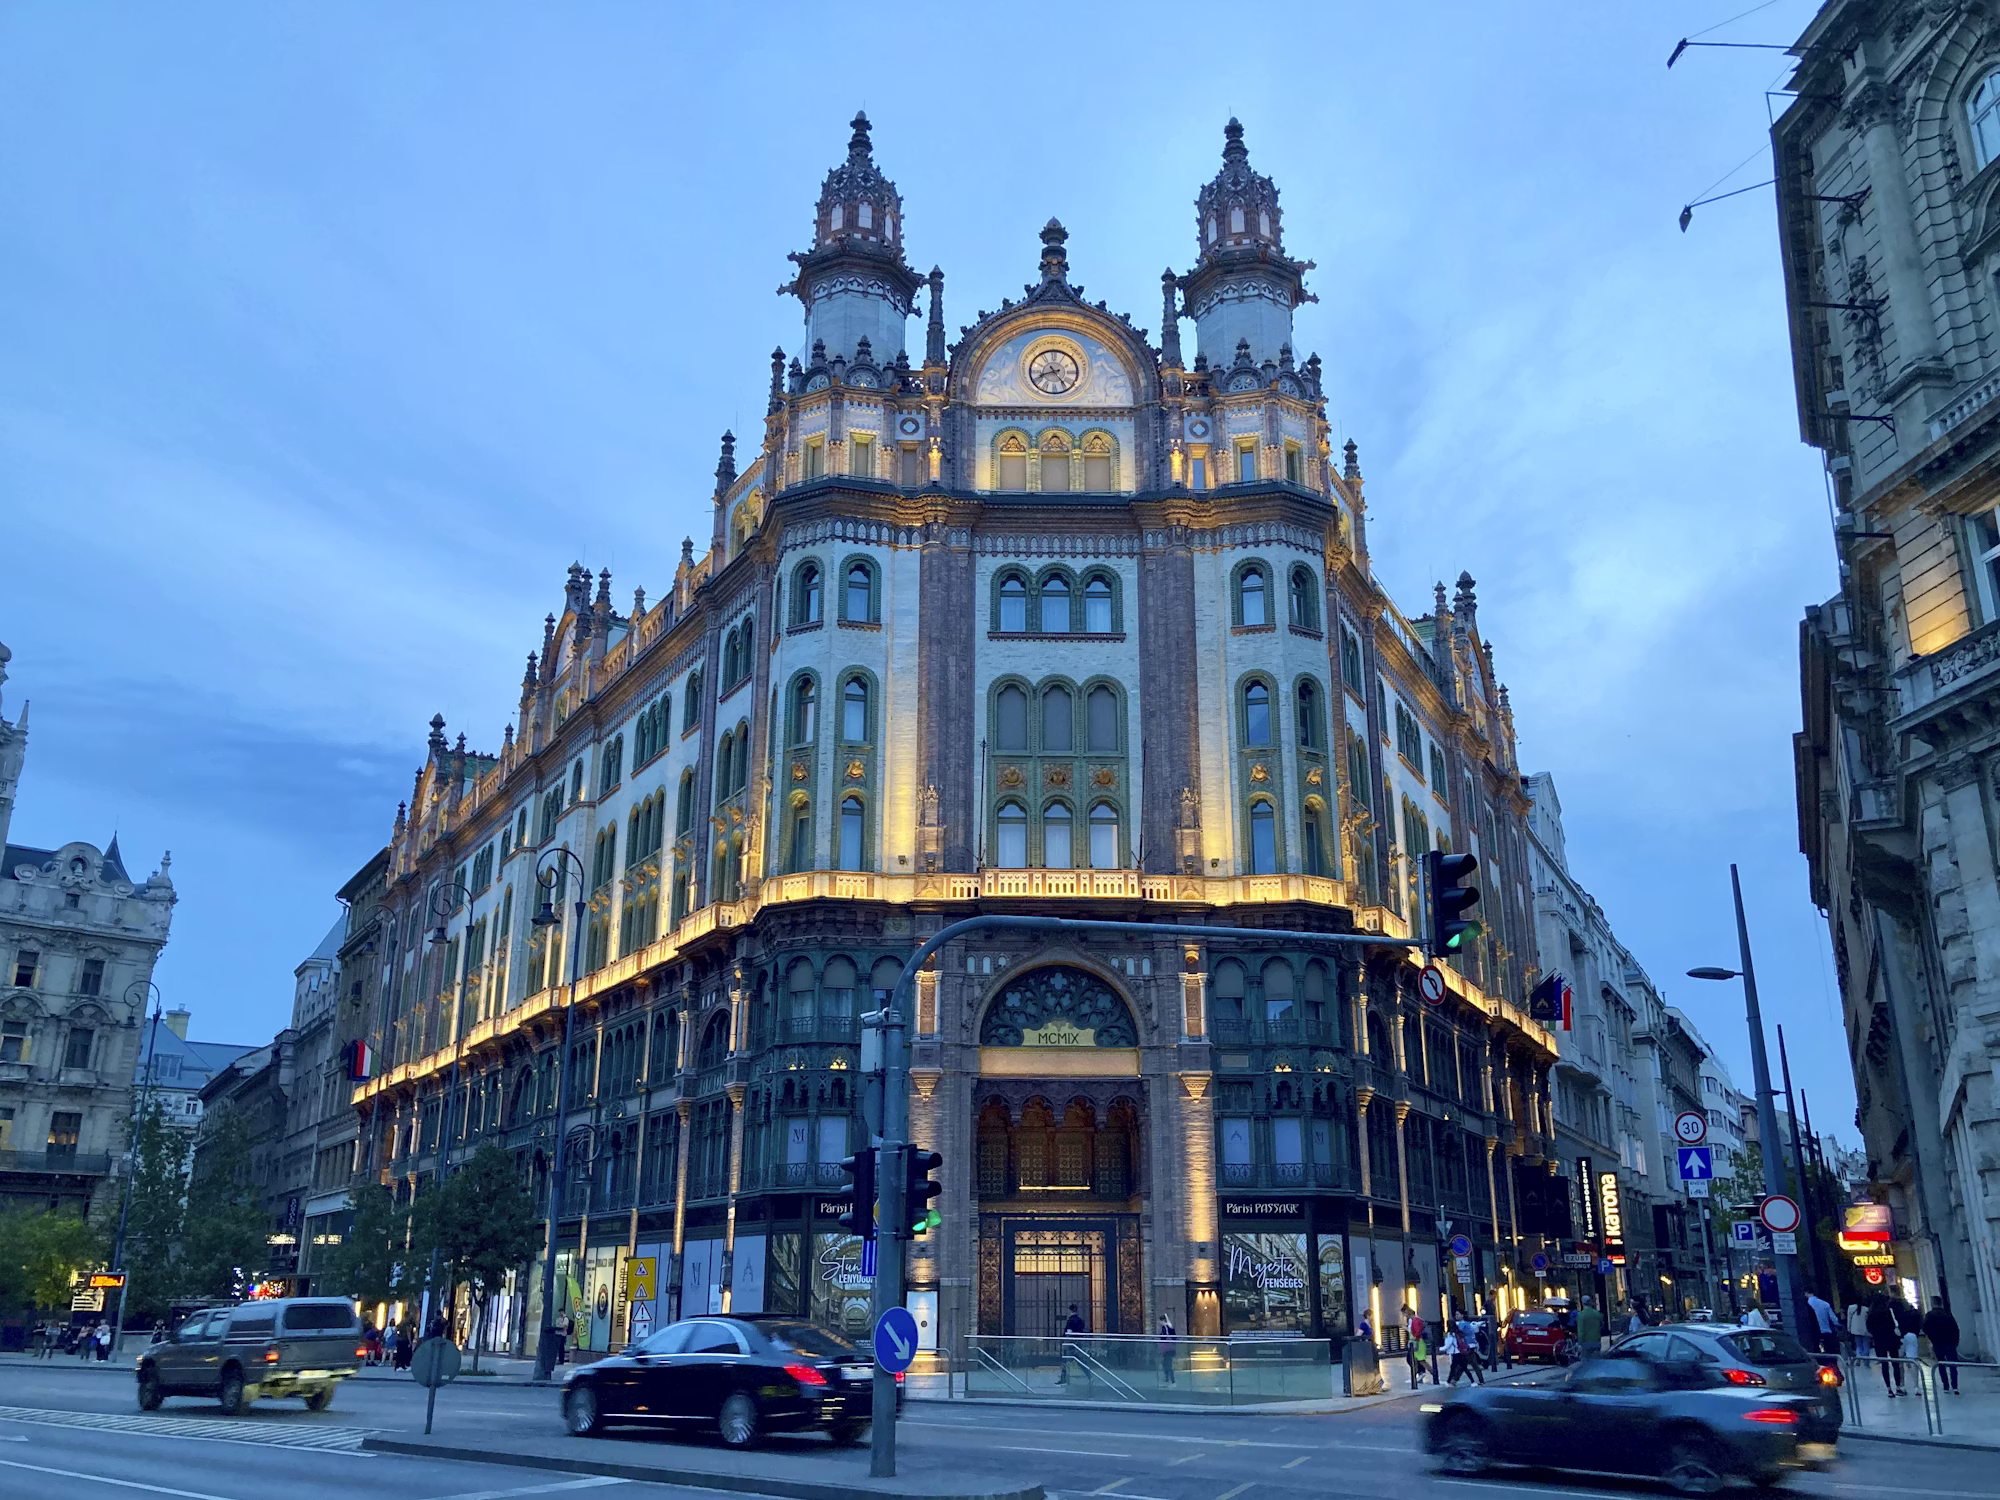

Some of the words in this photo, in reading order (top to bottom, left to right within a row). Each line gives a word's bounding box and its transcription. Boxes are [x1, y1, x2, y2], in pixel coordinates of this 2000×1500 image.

[1038, 1032, 1079, 1044] MCMIX
[1682, 1121, 1699, 1135] 30
[820, 1203, 848, 1214] Párisi
[1226, 1203, 1253, 1214] Párisi
[1255, 1203, 1299, 1214] PASSAGE
[1738, 1224, 1749, 1240] P
[820, 1247, 862, 1280] Stun
[1229, 1245, 1296, 1288] Majestic
[1854, 1255, 1894, 1266] CHANGE
[1264, 1276, 1303, 1288] FENSÉGES
